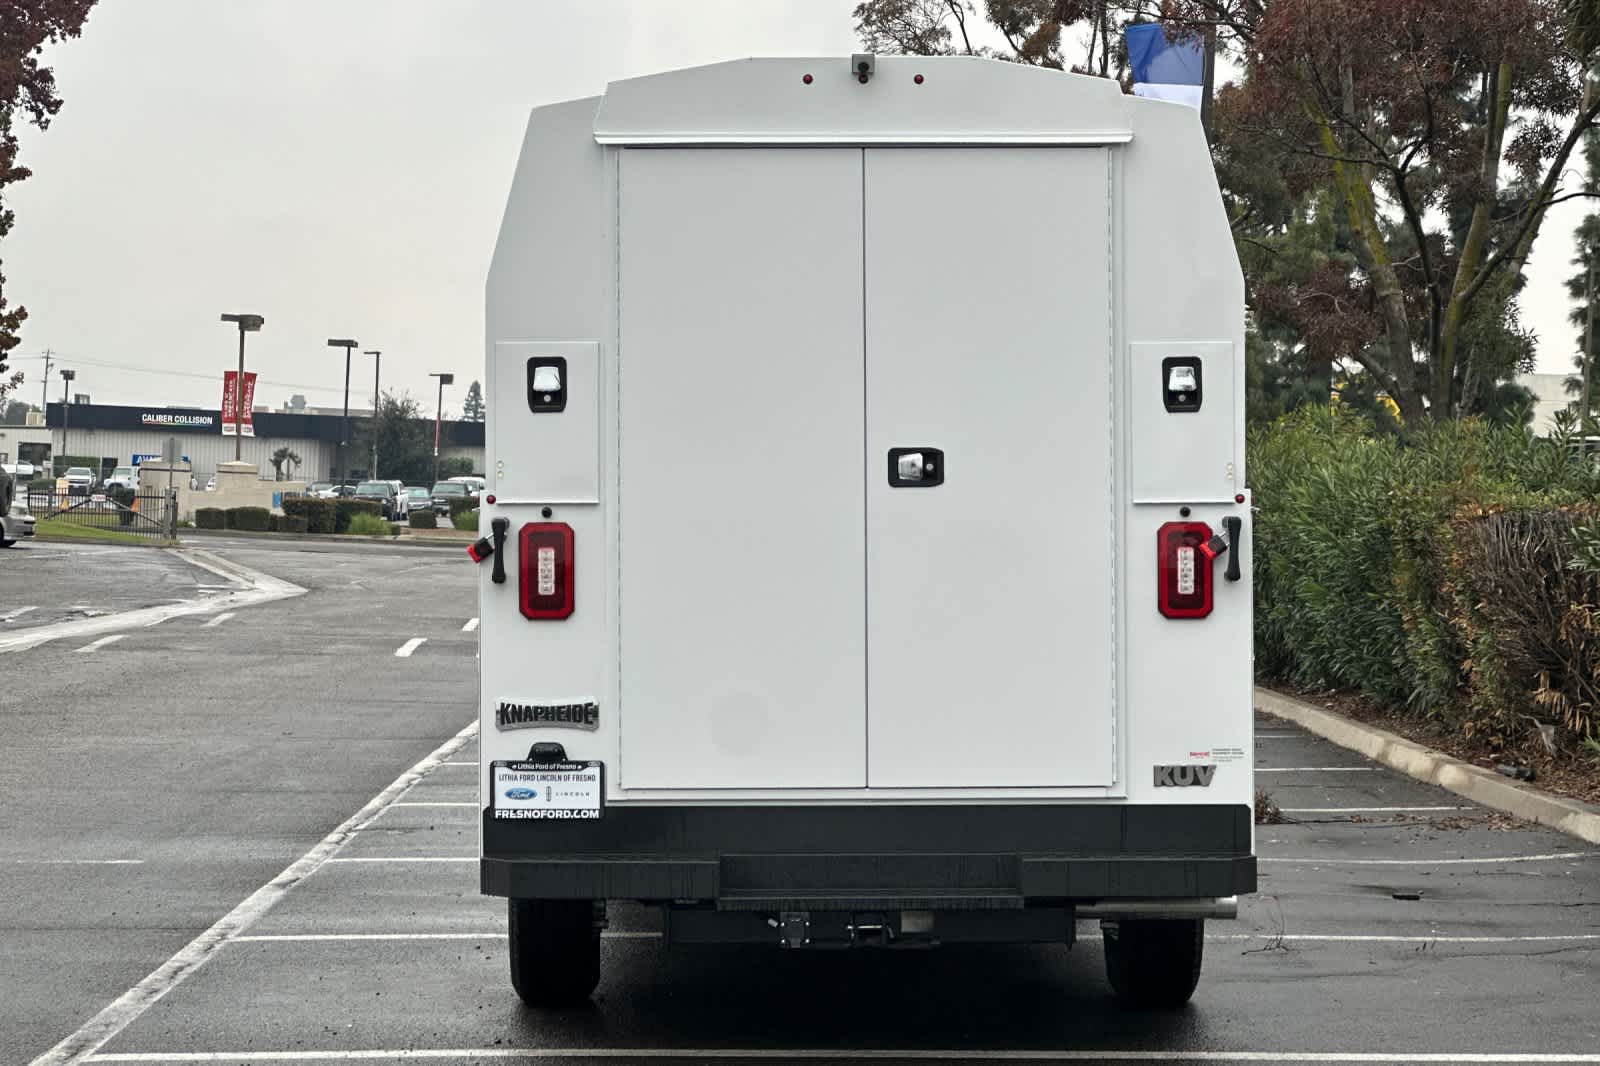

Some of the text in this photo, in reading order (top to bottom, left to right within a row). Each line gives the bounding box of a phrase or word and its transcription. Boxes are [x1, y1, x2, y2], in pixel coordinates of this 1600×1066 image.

[142, 414, 213, 424] CALIBER COLLISION
[500, 702, 594, 725] KNAPHEIDE
[499, 774, 596, 782] LITHIA FORD LINCOLN OF FRESNO
[1153, 765, 1217, 787] KUV
[495, 810, 600, 818] FRESNOFORD.COM
